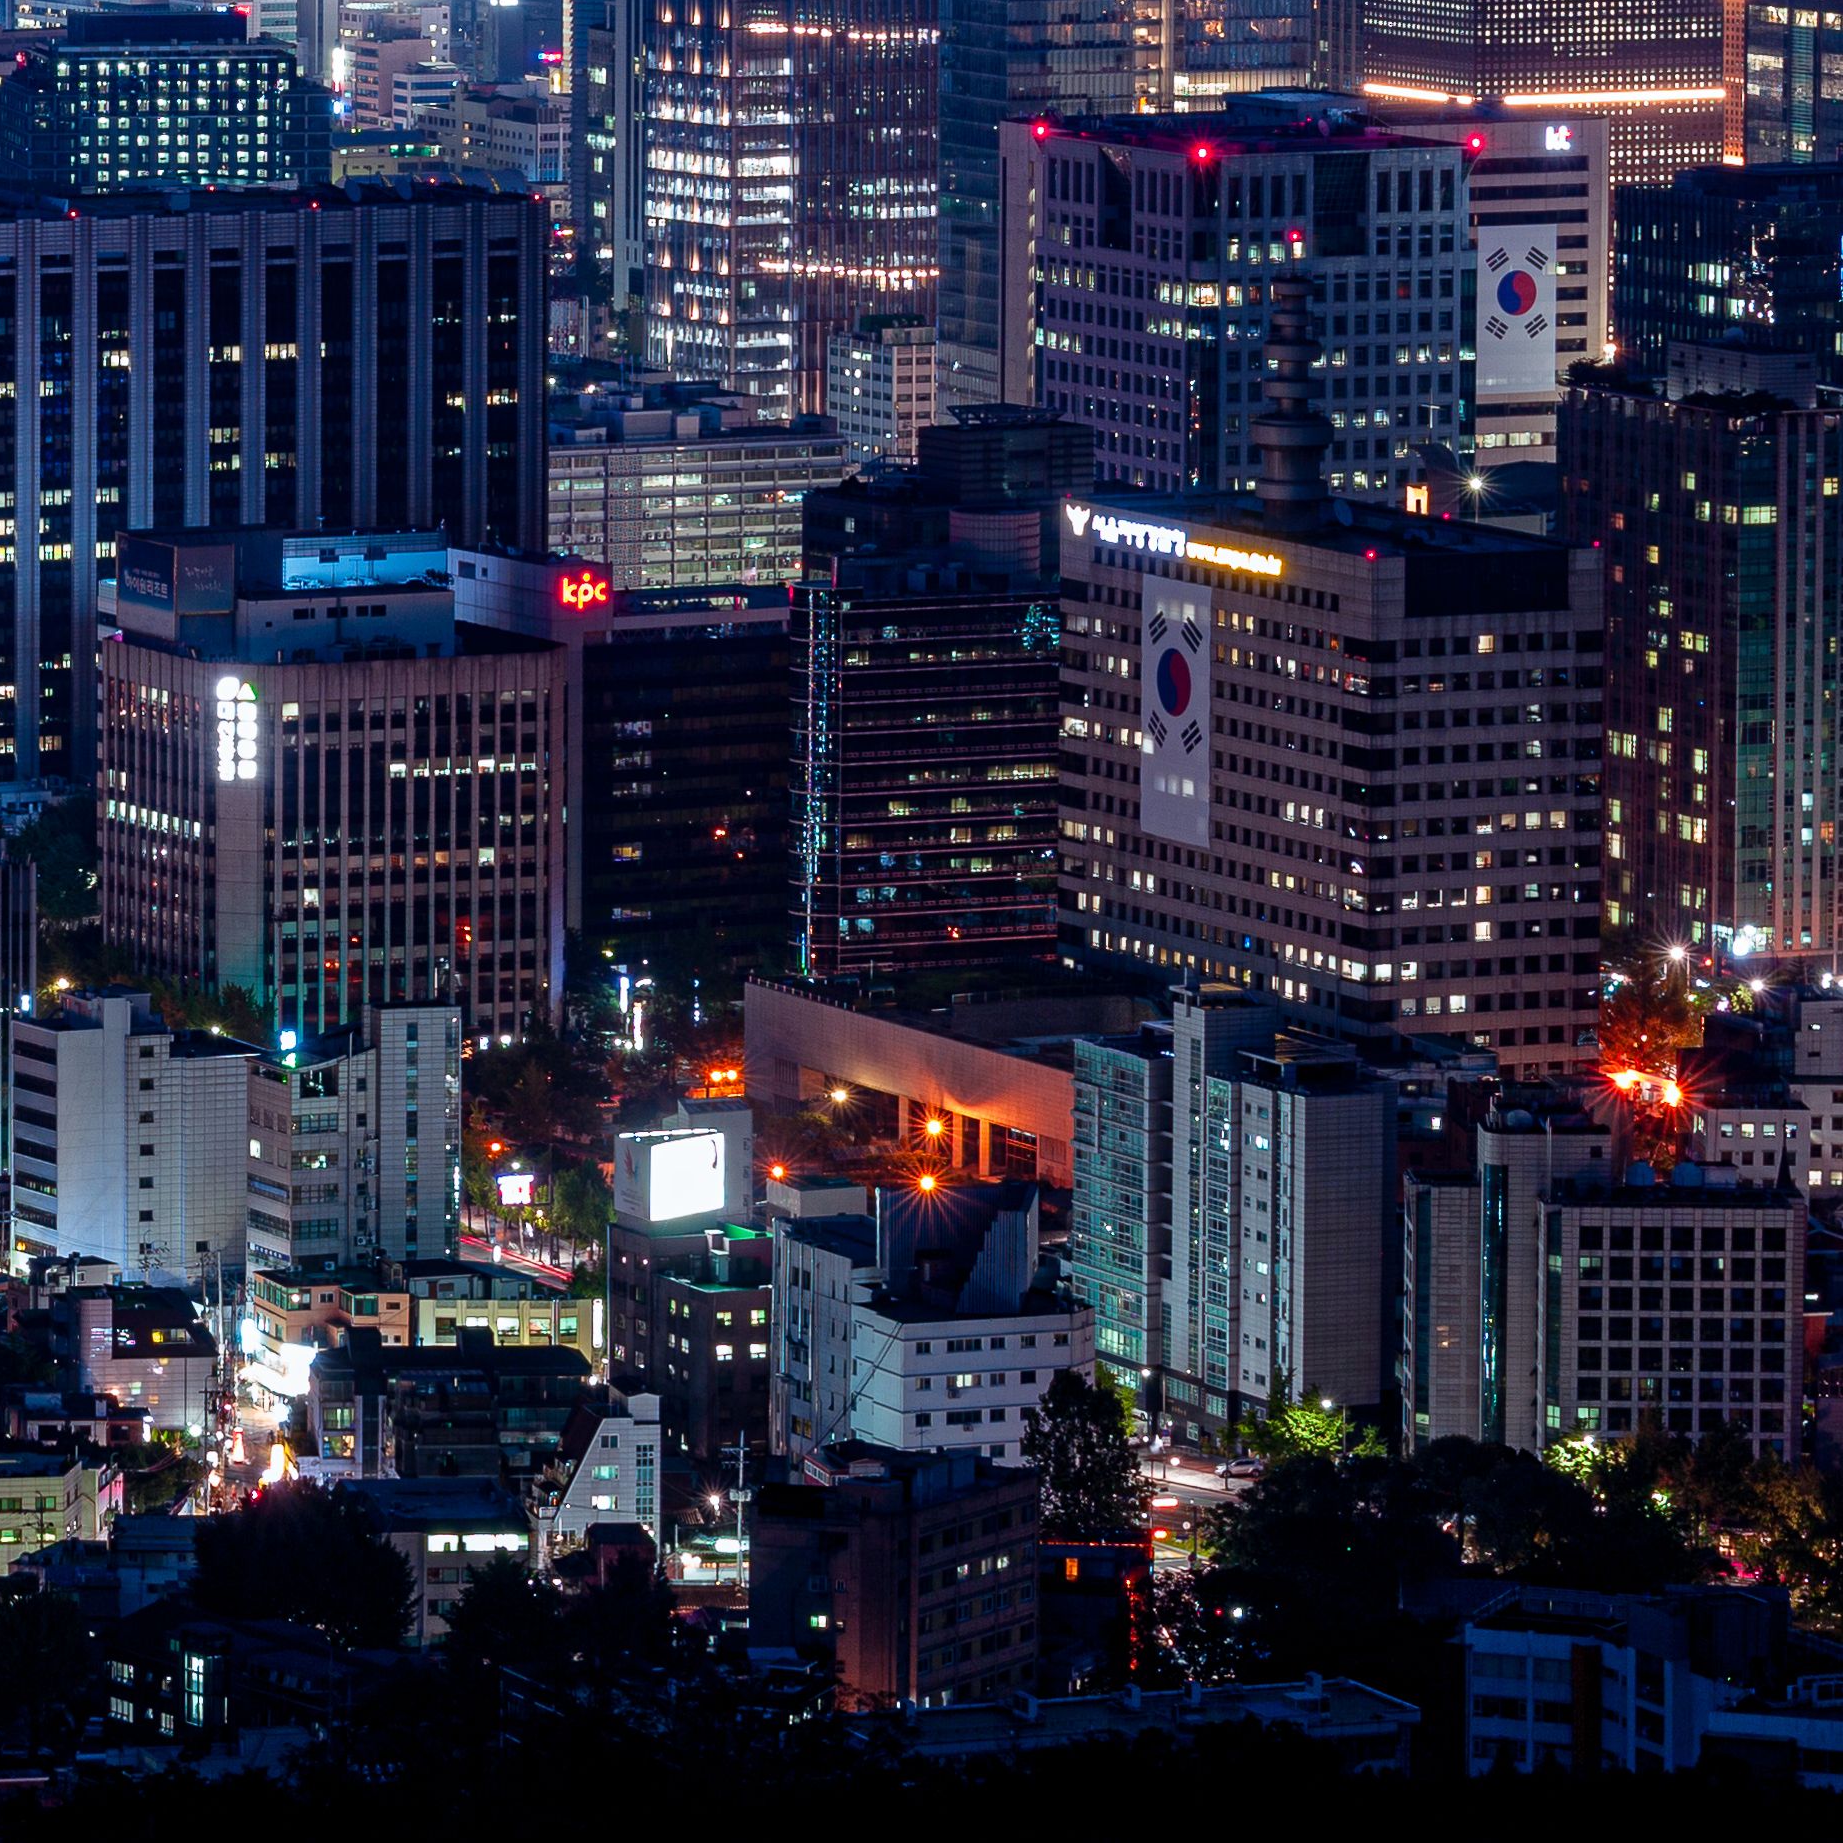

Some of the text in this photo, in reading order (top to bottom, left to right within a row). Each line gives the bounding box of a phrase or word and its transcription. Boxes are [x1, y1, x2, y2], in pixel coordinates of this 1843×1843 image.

[1545, 125, 1572, 150] kt
[124, 569, 169, 599] 하이원리조트
[562, 573, 607, 609] kpc
